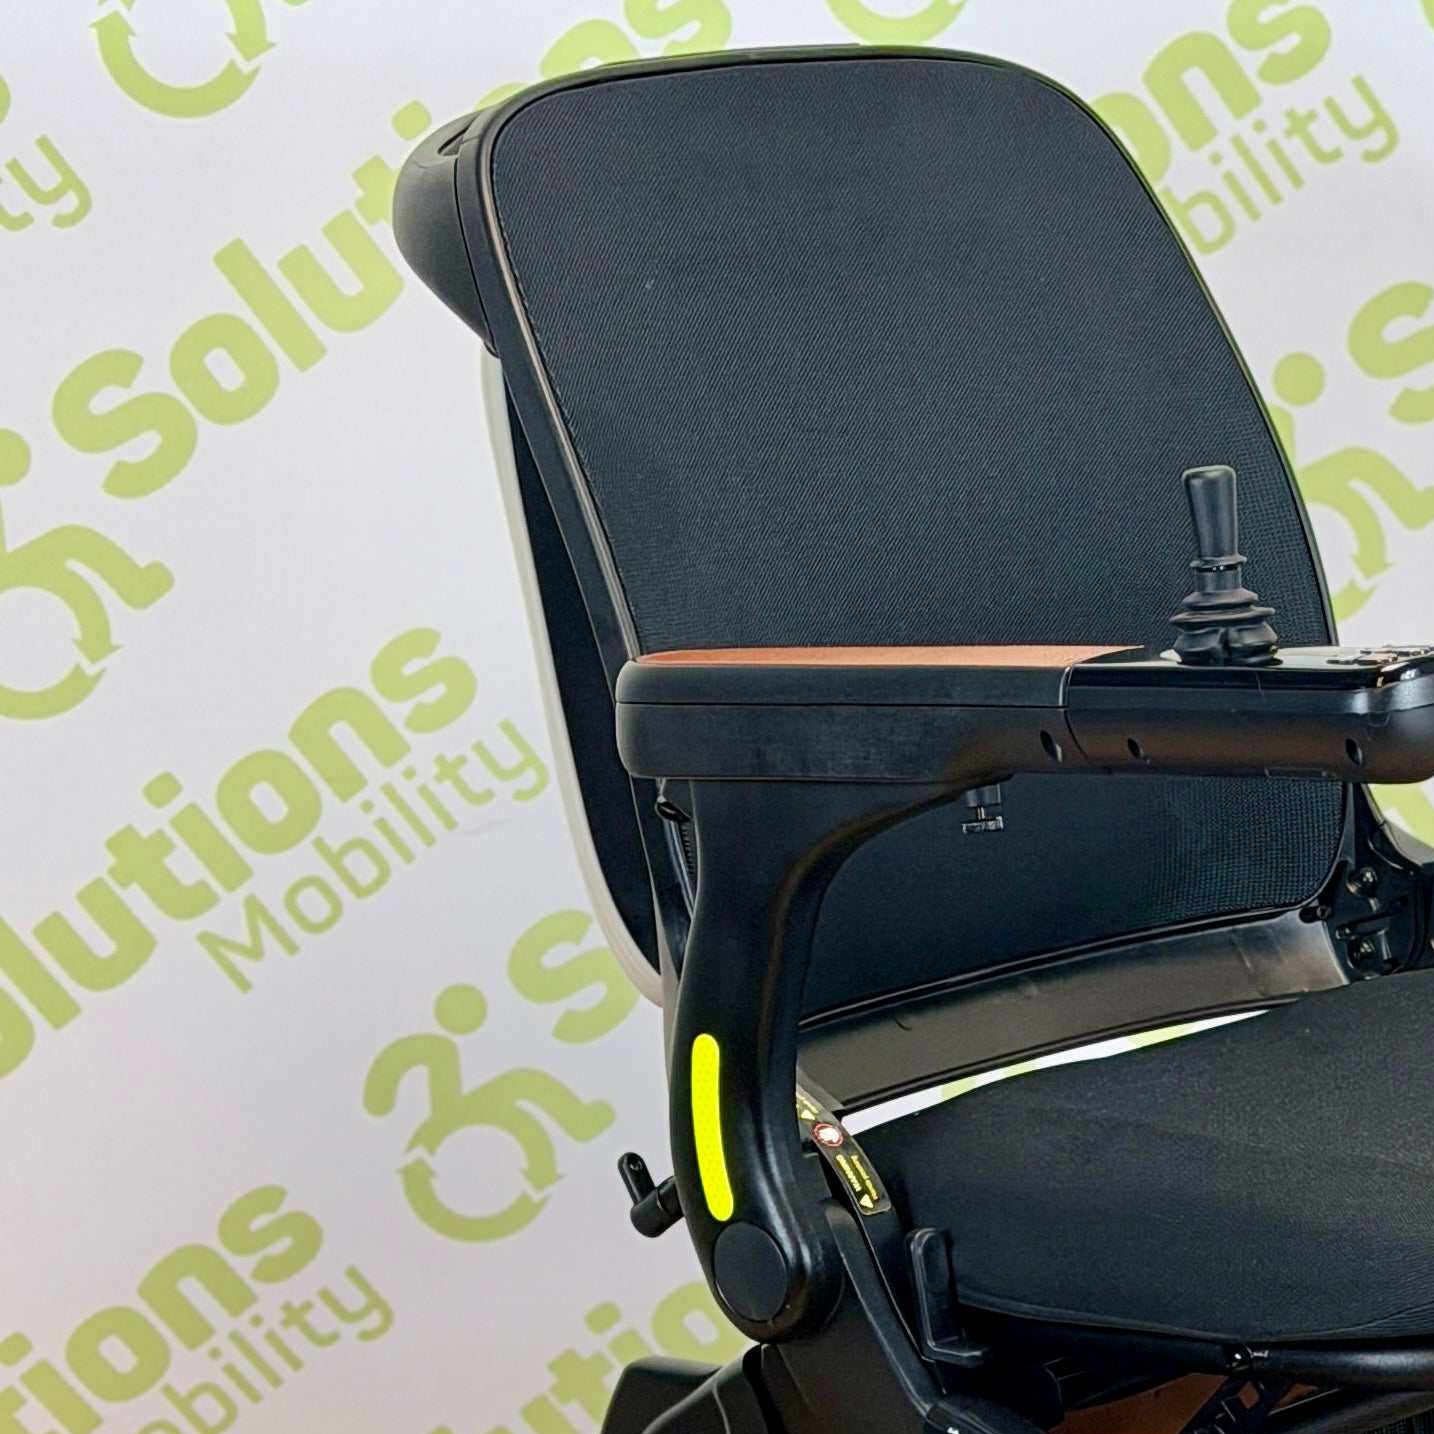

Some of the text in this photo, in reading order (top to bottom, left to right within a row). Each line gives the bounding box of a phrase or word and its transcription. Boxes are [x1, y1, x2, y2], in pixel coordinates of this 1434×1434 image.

[1159, 75, 1398, 256] bility
[0, 627, 478, 1080] lutions
[196, 719, 550, 994] Mobility
